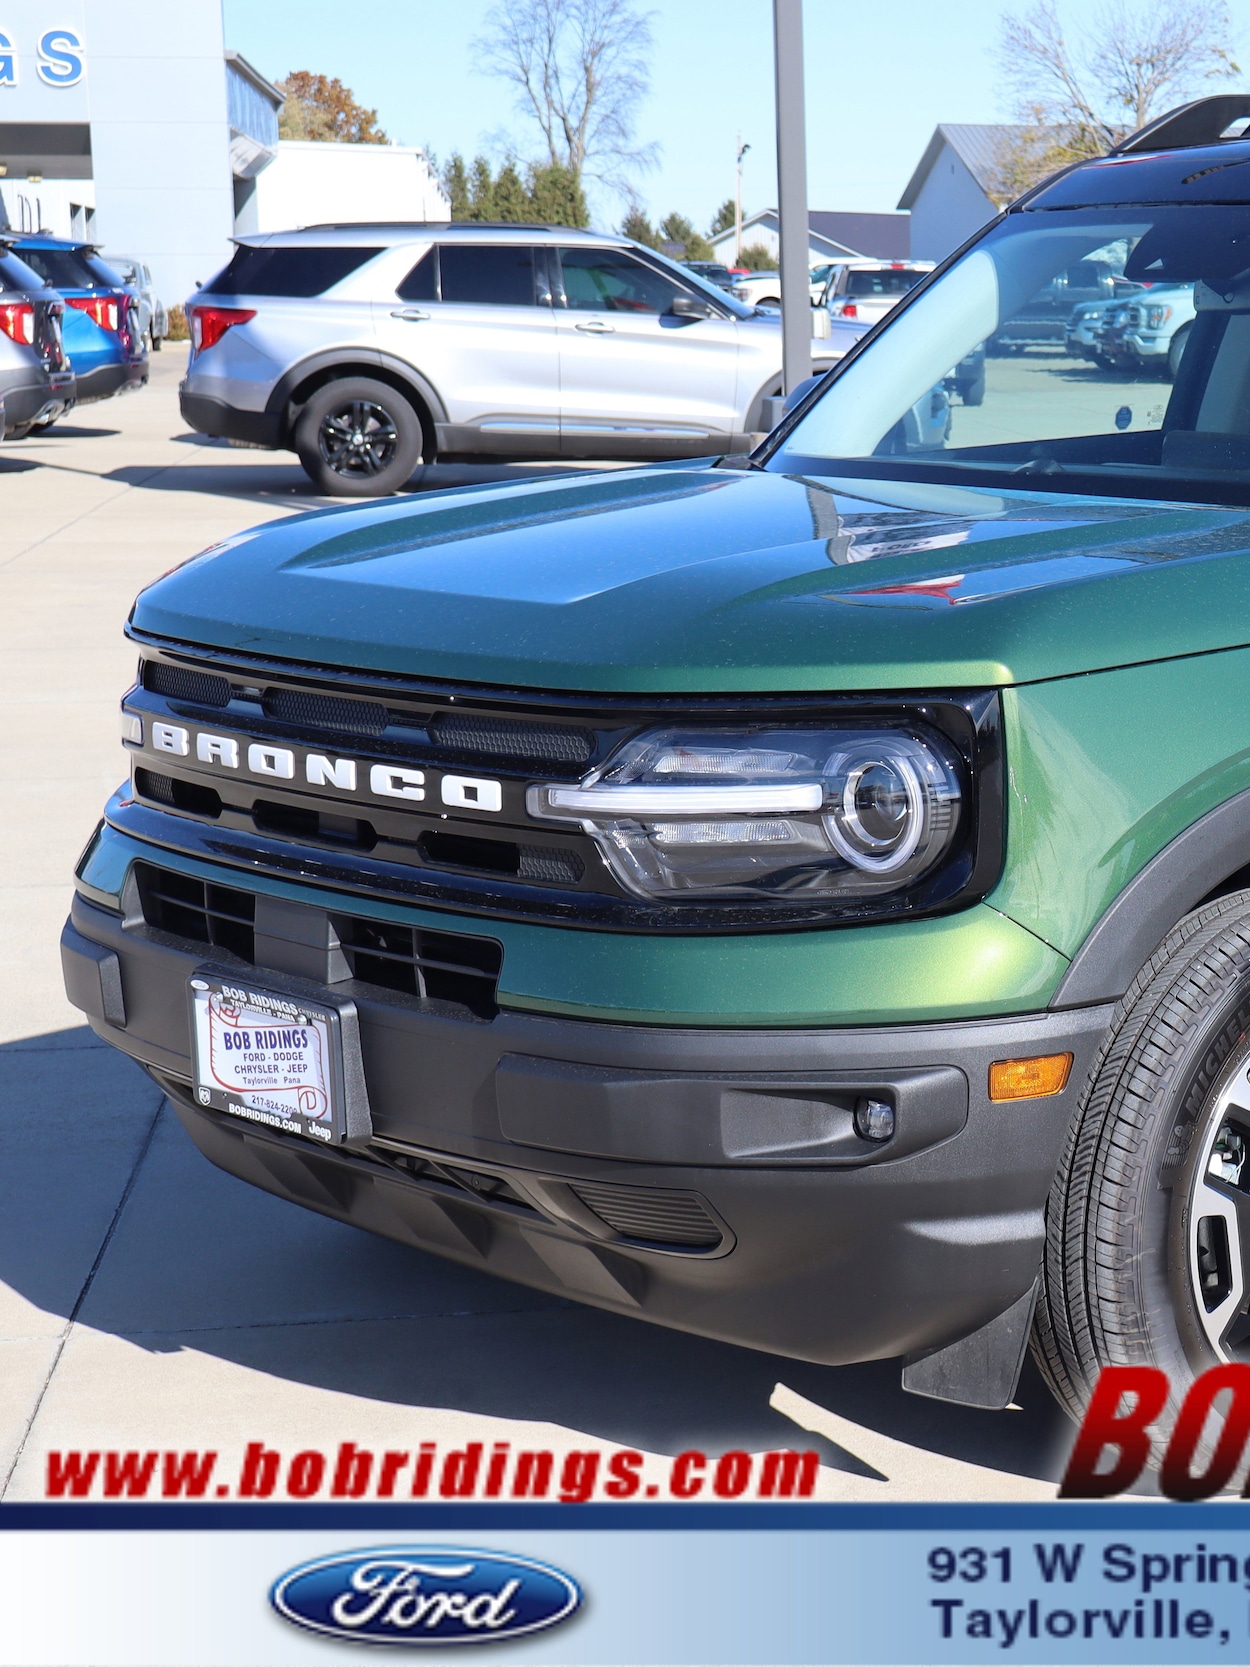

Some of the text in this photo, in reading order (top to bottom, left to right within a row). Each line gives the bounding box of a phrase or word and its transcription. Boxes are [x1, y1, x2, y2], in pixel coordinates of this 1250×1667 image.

[152, 721, 502, 812] BRONCO
[222, 985, 298, 1016] BOB RIDINGS
[224, 1029, 308, 1050] BOB RIDINGS
[243, 1052, 266, 1062] FORD
[273, 1052, 304, 1061] DODGE
[234, 1064, 280, 1074] CHRYSLER
[287, 1064, 308, 1073] JEEP
[243, 1075, 301, 1086] Taylorville Pana
[228, 1103, 302, 1134] BOBRIDINGS.COM
[309, 1121, 332, 1141] Jeep
